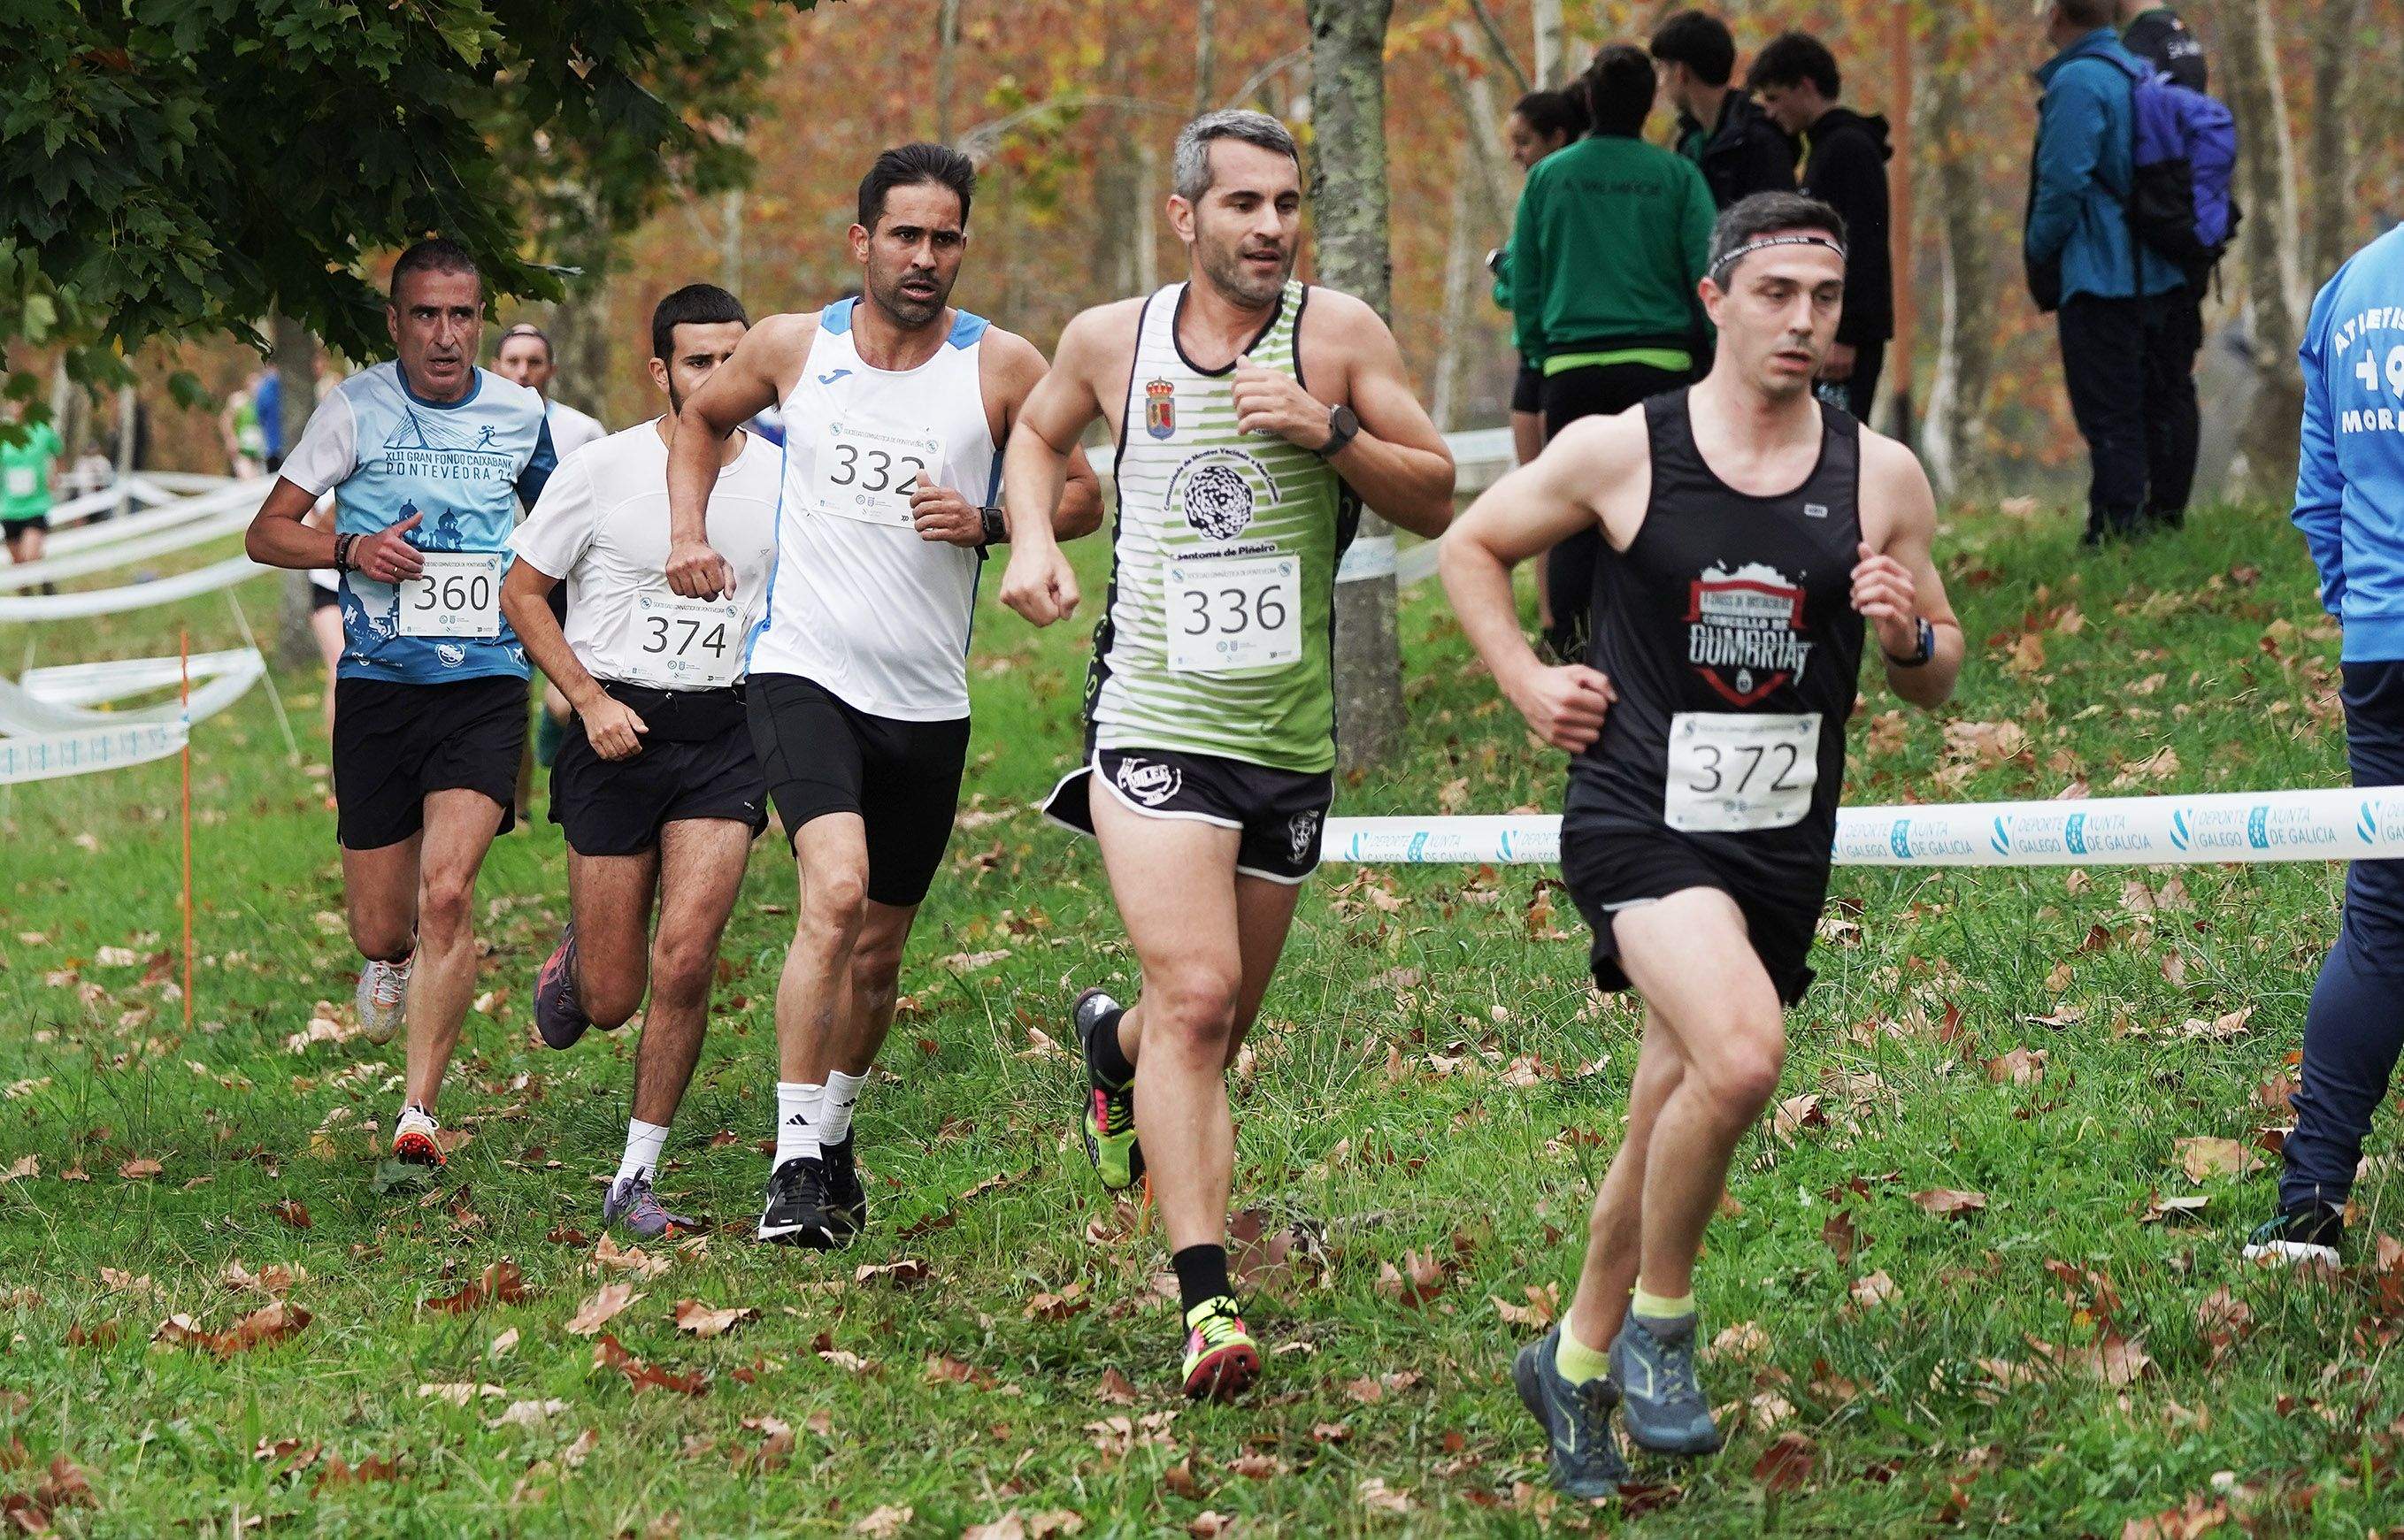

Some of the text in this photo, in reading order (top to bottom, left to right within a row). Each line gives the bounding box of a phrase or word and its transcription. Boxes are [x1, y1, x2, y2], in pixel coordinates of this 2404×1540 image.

[407, 451, 433, 464] GRAN
[435, 454, 465, 465] FONDO
[467, 456, 513, 471] CAIXABANK
[386, 462, 491, 480] PONTEVEDRA
[830, 444, 926, 496] 332
[1224, 548, 1237, 557] de
[413, 574, 489, 611] 360
[1183, 584, 1286, 636] 336
[642, 616, 726, 659] 374
[1690, 741, 1800, 794] 372
[2017, 816, 2064, 831] DEPORTE
[2198, 809, 2246, 825] DEPORTE
[1845, 822, 1888, 838] DEPORTE
[2018, 839, 2062, 854] GALEGO
[2199, 831, 2243, 848] GALEGO
[1846, 844, 1888, 858] GALEGO
